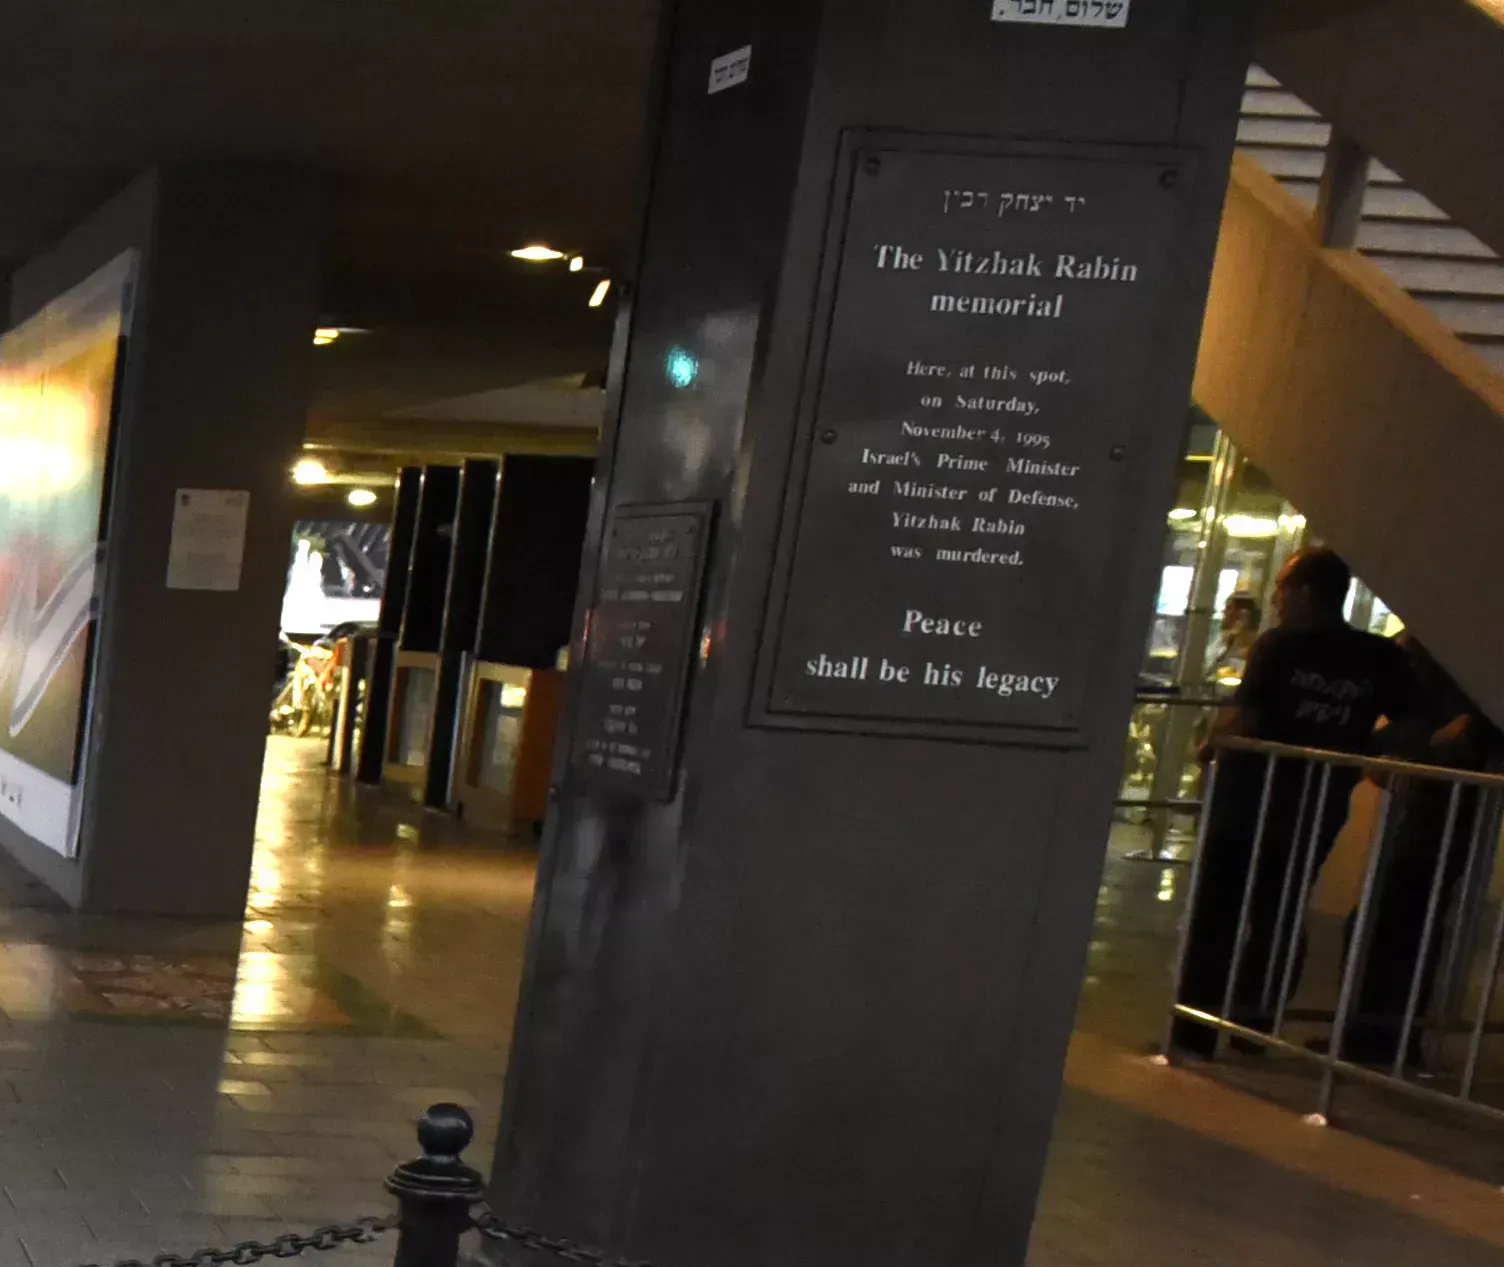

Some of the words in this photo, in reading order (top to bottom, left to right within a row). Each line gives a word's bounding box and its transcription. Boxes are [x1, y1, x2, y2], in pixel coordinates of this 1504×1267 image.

[1056, 0, 1124, 20] שלום,
[944, 190, 989, 213] רבין
[998, 192, 1053, 217] יצחק
[1064, 196, 1086, 213] יד
[874, 244, 924, 270] The
[936, 248, 1043, 277] Yitzhak
[1054, 254, 1139, 282] Rabin
[930, 293, 1064, 318] memorial
[906, 361, 952, 378] Here,
[959, 365, 975, 379] at
[983, 365, 1017, 381] this
[1029, 369, 1071, 385] spot,
[920, 395, 942, 408] on
[955, 395, 1040, 416] Saturday,
[900, 421, 986, 441] November
[1016, 431, 1051, 449] 1995
[862, 448, 921, 467] Israel's
[937, 453, 989, 472] Prime
[1005, 457, 1081, 477] Minister
[848, 480, 881, 494] and
[893, 480, 968, 501] Minister
[979, 487, 998, 502] of
[1008, 489, 1079, 509] Defense,
[892, 512, 961, 531] Yitzhak
[972, 517, 1025, 535] Rabin
[890, 545, 923, 559] was
[936, 547, 1024, 565] murdered.
[903, 609, 983, 637] Peace
[805, 654, 869, 680] shall
[879, 658, 910, 683] be
[924, 661, 964, 687] his
[976, 665, 1060, 699] legacy
